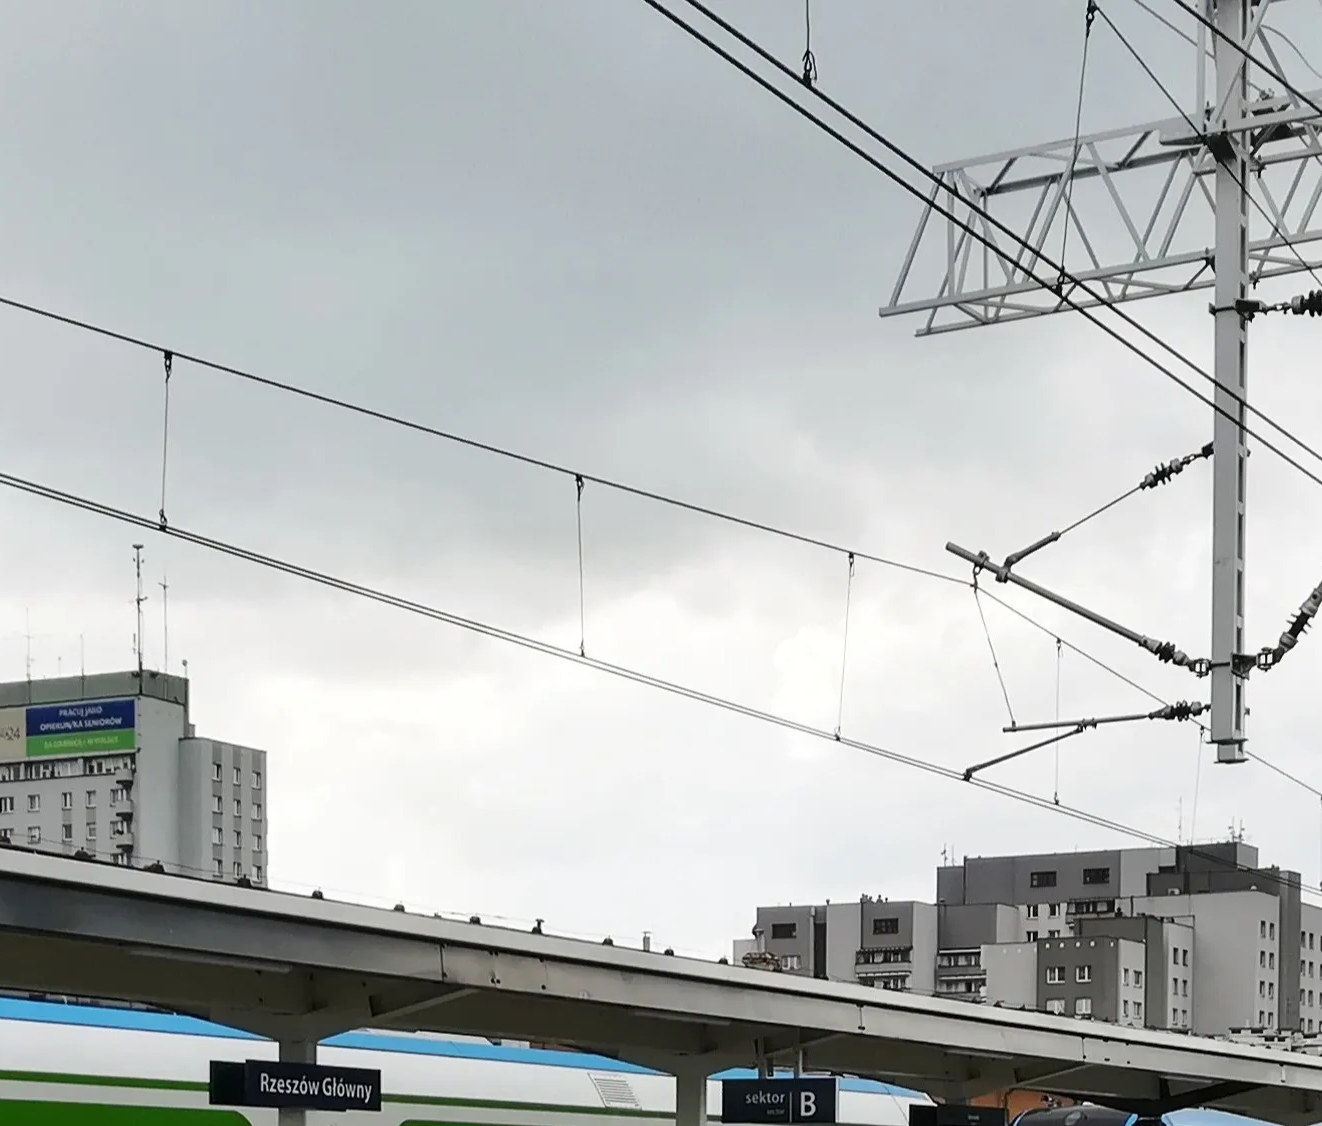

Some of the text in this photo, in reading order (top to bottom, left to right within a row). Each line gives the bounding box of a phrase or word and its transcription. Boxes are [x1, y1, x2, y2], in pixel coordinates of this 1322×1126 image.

[260, 1072, 373, 1104] Rzeszów Główny
[745, 1090, 817, 1117] sektor B
